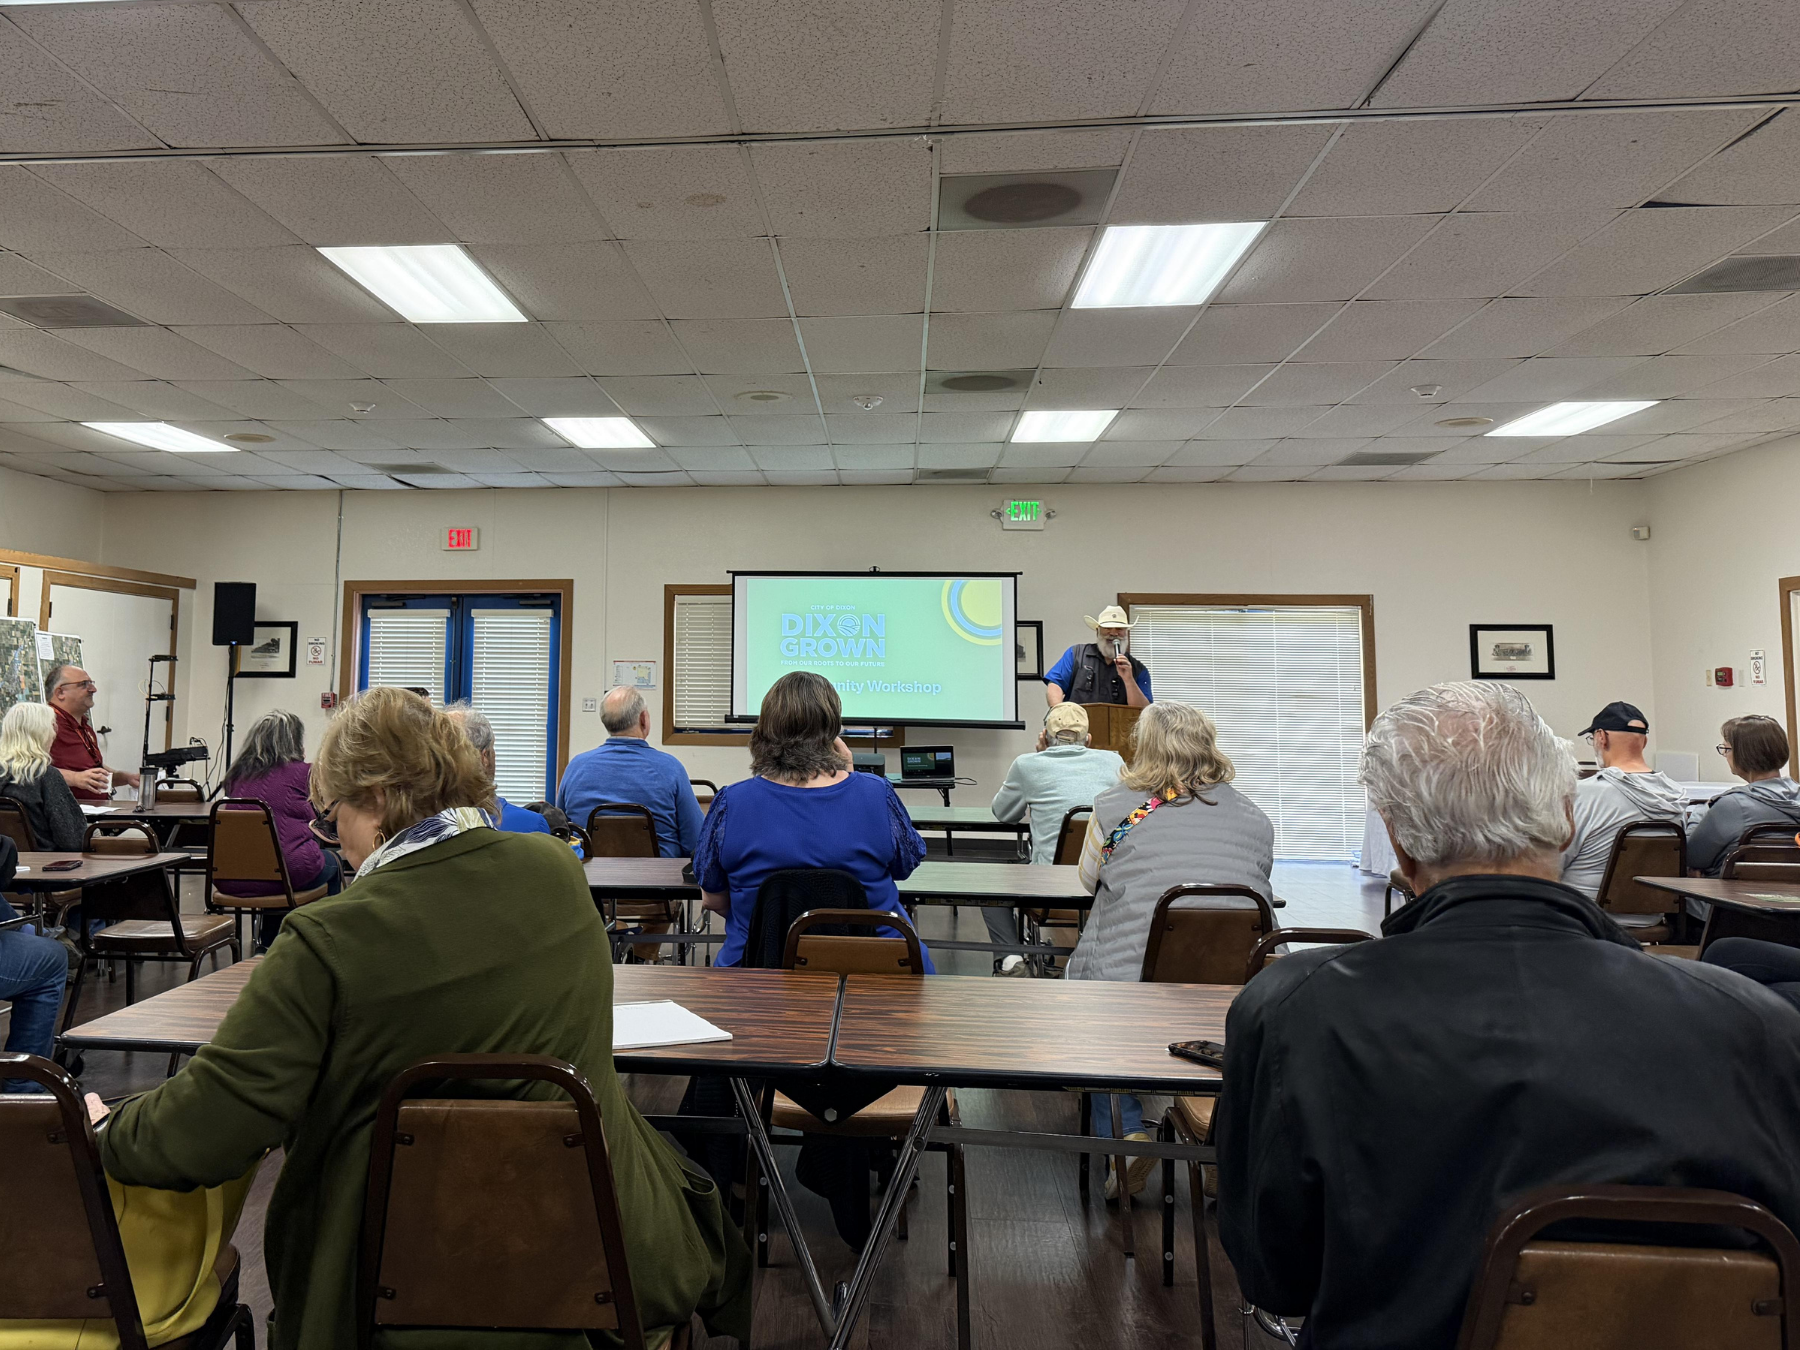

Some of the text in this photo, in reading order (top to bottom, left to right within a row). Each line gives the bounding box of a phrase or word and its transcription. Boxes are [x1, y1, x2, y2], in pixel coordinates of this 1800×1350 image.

[1010, 501, 1040, 521] EXIT
[448, 528, 472, 548] EXIT
[781, 613, 886, 637] DIXON
[780, 638, 886, 658] GROWN
[867, 680, 942, 696] Workshop
